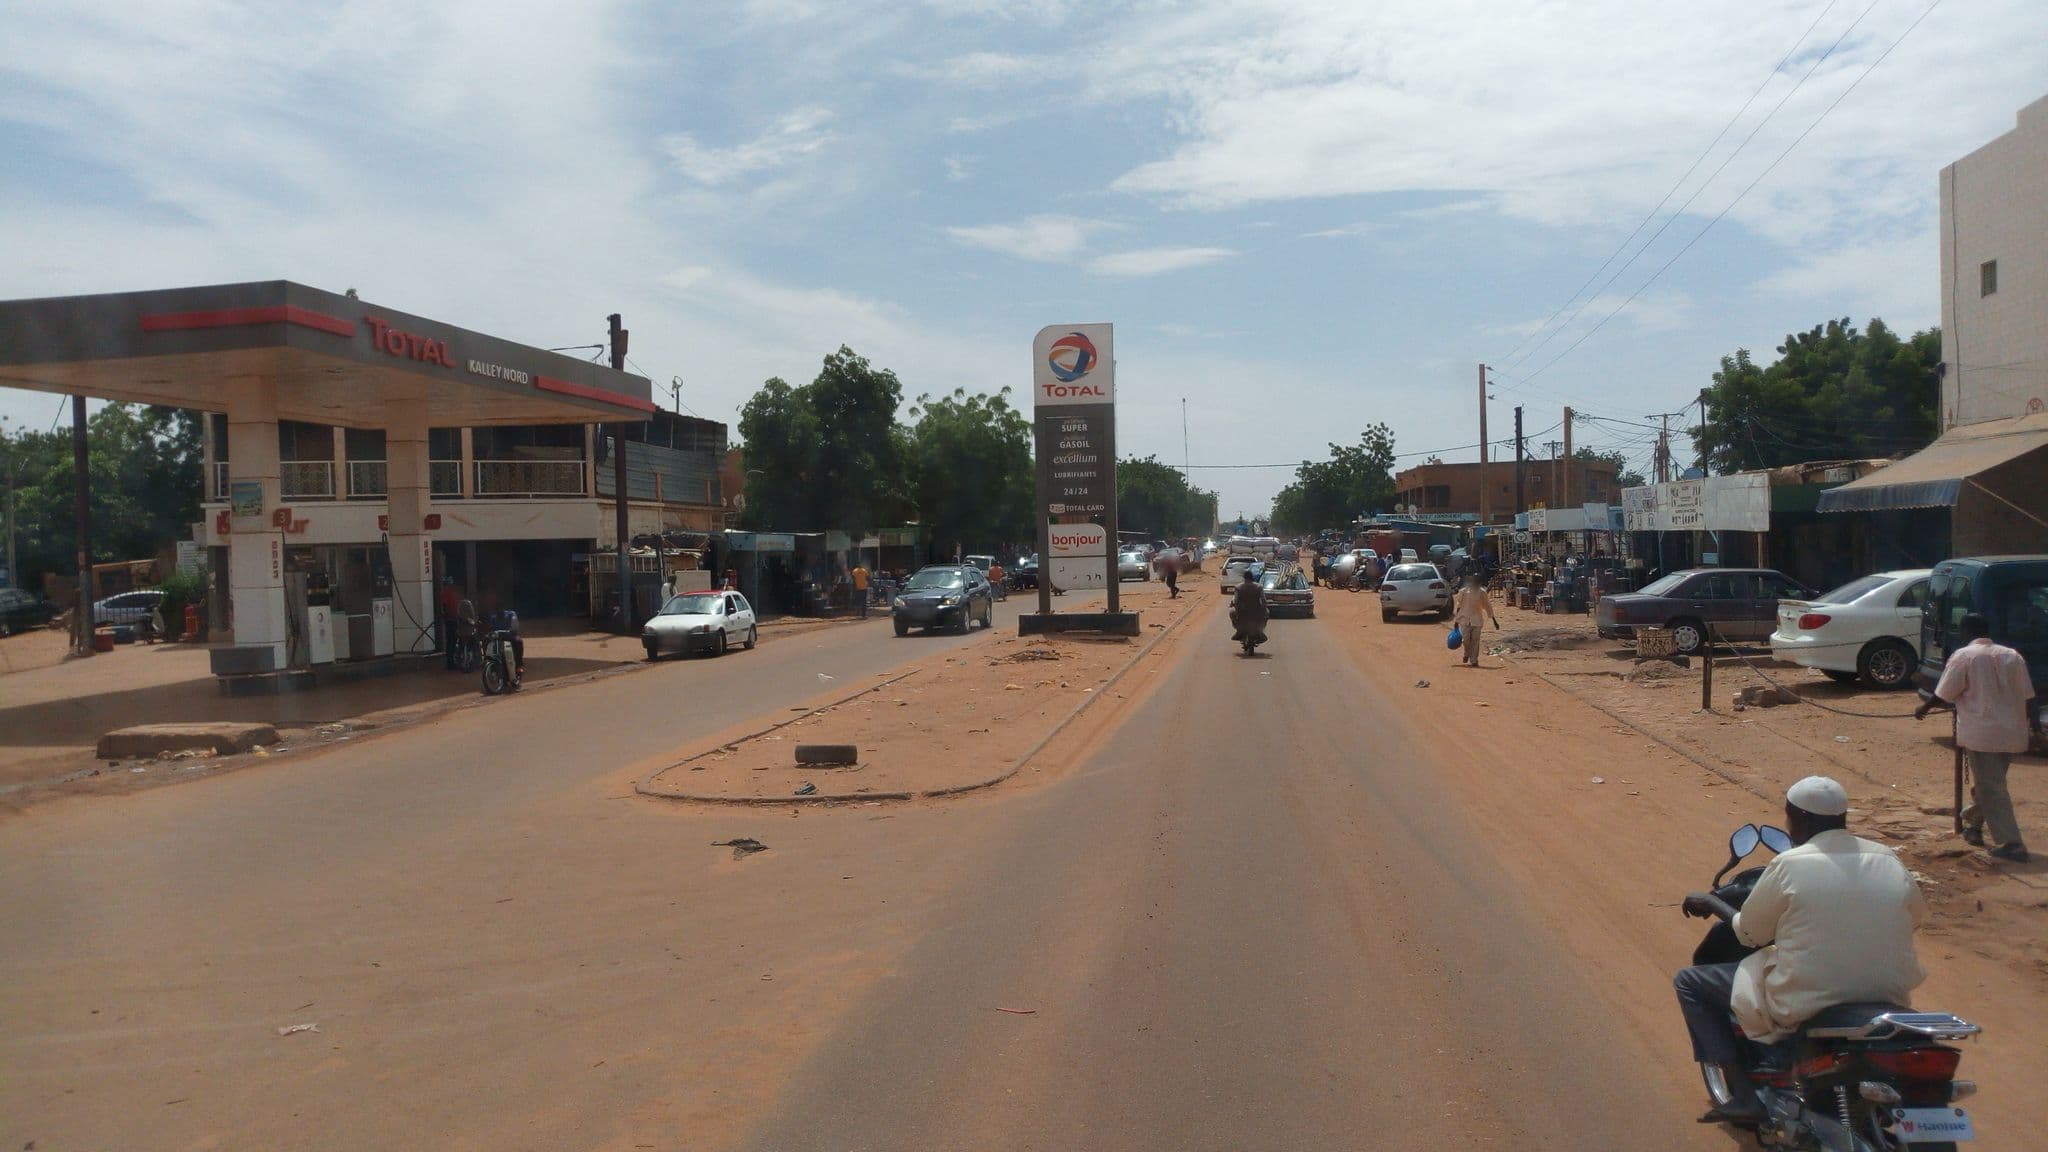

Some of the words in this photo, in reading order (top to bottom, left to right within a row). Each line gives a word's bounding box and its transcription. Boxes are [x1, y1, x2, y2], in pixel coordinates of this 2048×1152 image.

[364, 314, 457, 368] TOTAL
[469, 359, 501, 379] KALLEY
[503, 367, 528, 384] NORD
[1042, 384, 1105, 397] TOTAL
[1061, 424, 1088, 432] SUPER
[1059, 441, 1091, 449] GASOIL
[1053, 452, 1097, 464] excellium
[1054, 471, 1097, 479] LUBRIFIANTS
[1063, 487, 1088, 496] 24/24
[1051, 533, 1102, 548] bonjour
